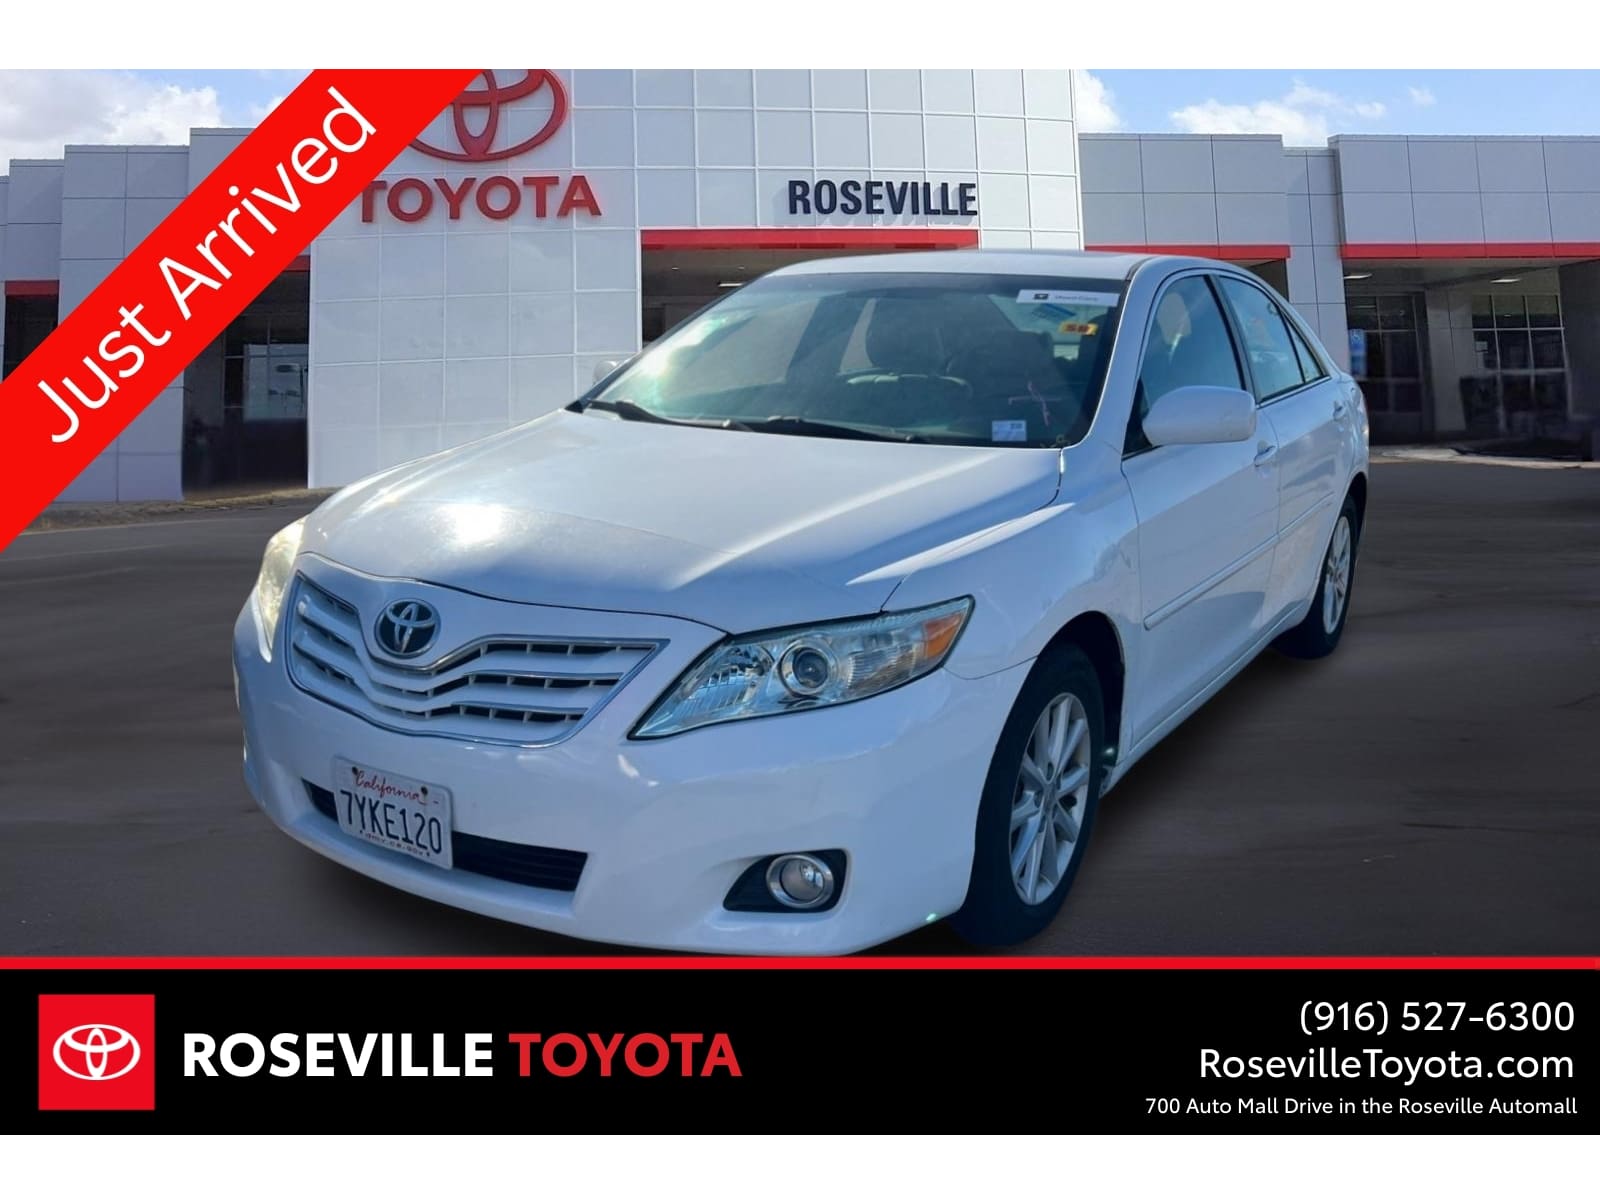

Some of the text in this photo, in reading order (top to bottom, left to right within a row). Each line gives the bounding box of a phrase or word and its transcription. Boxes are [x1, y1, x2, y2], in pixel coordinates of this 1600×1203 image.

[361, 175, 603, 223] TOYOTA
[787, 179, 978, 216] ROSEVILLE
[356, 769, 427, 806] California
[340, 789, 442, 855] 7YKE120
